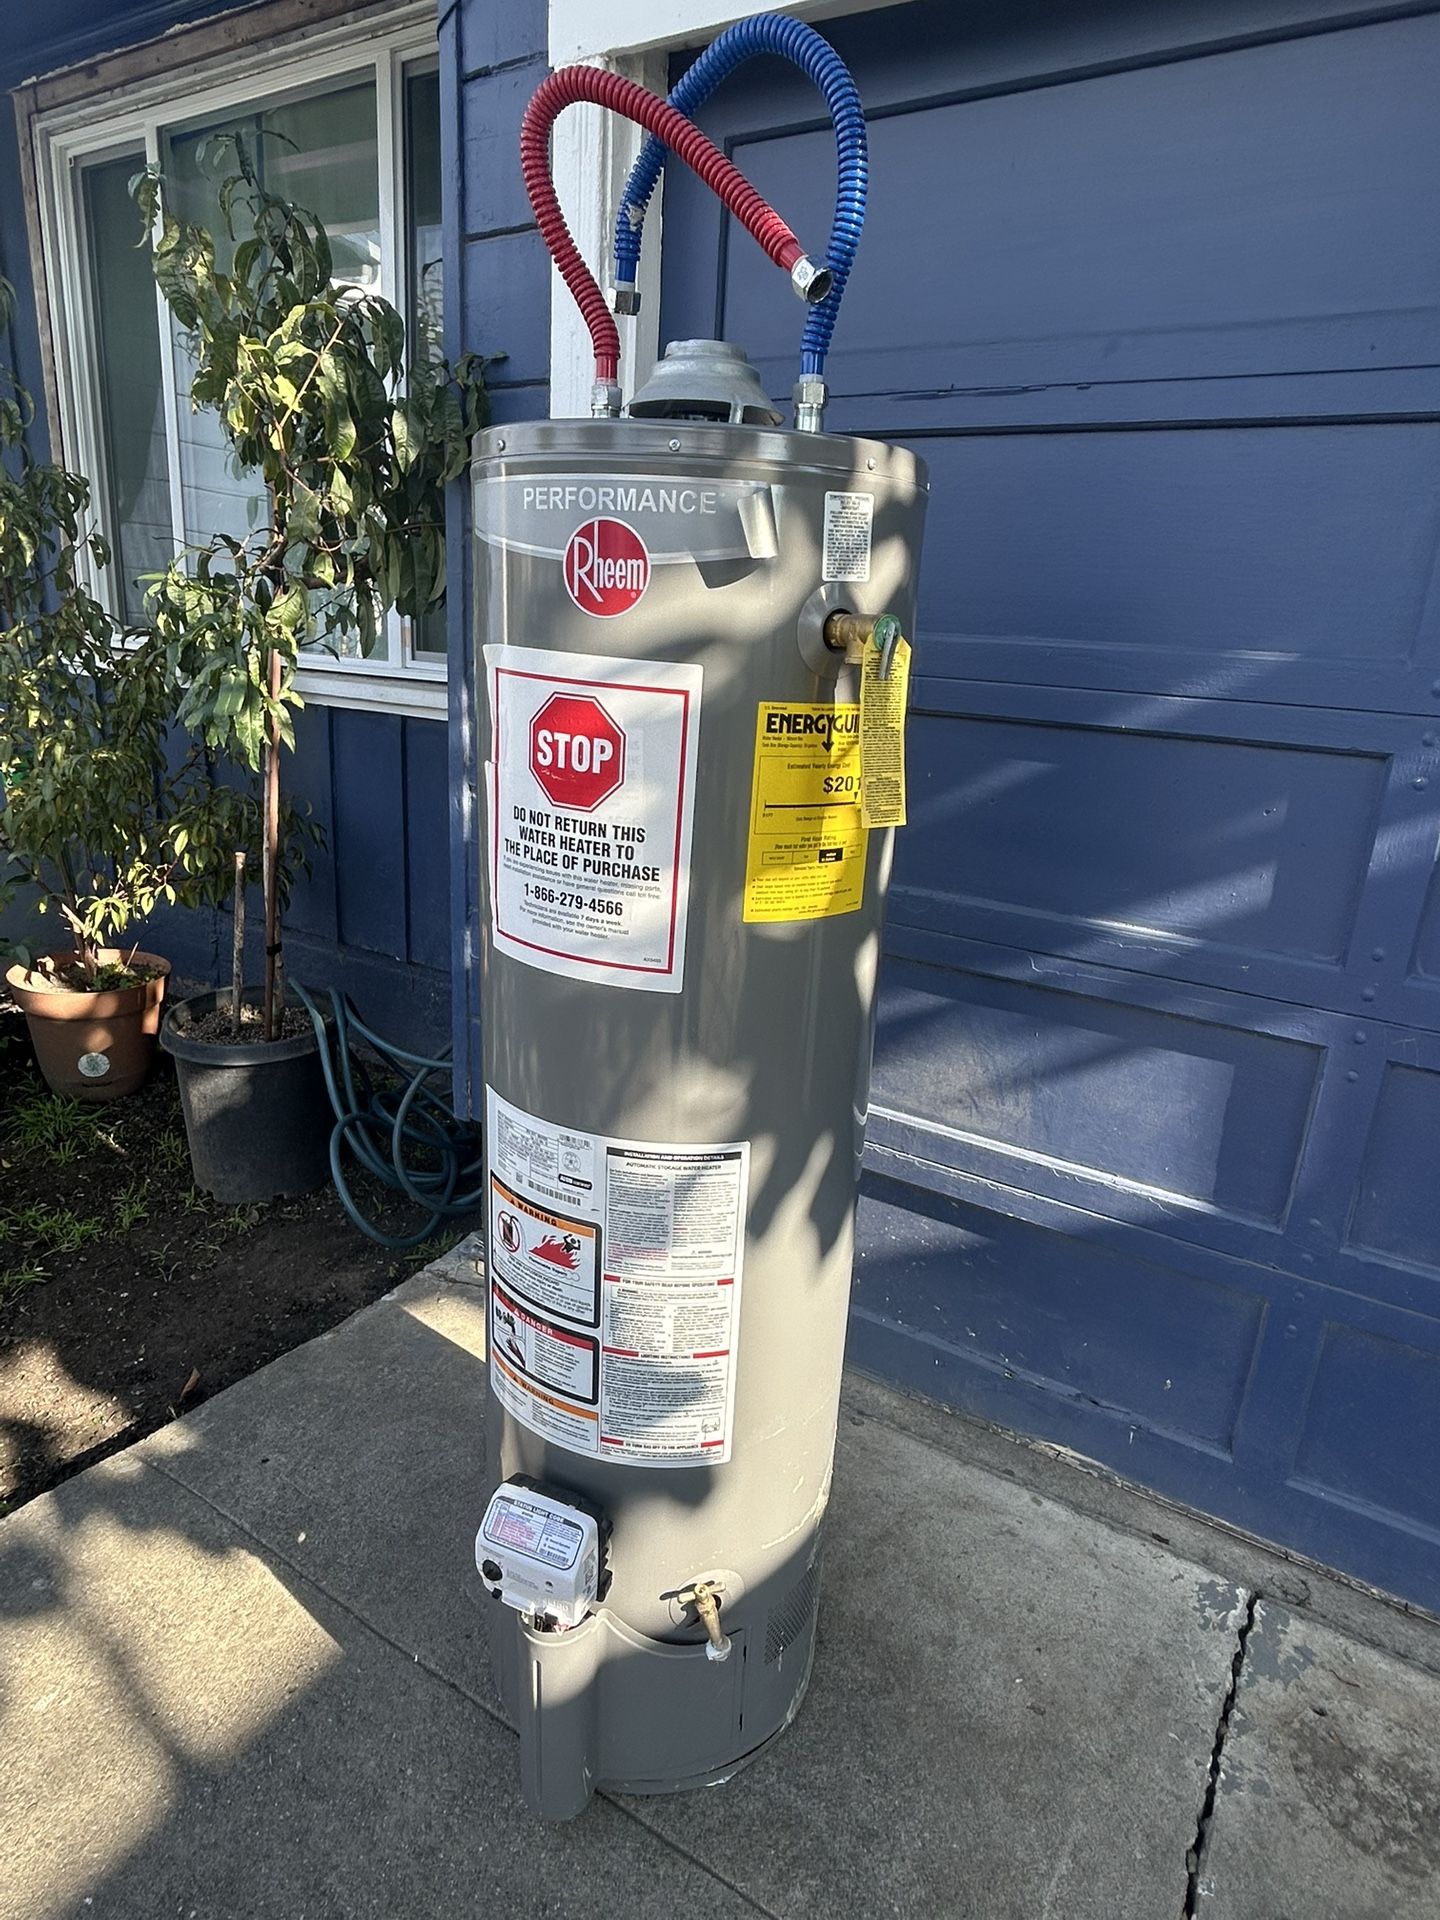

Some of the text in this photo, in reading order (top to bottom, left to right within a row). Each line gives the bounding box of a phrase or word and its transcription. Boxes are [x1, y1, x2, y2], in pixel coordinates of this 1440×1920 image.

[523, 487, 717, 514] PERFORMANCE
[573, 520, 644, 602] Rheem
[766, 713, 859, 734] ENERGYGUI
[537, 729, 613, 774] STOP
[513, 805, 646, 843] DO NOT RETURN THIS
[519, 825, 635, 861] WATER HEATER TO
[504, 838, 660, 882] THE PLACE OF PURCHASE
[532, 873, 556, 883] assistance
[524, 882, 623, 916] 1-866-279-4566
[558, 910, 580, 920] available
[586, 924, 606, 932] owner's
[624, 1151, 660, 1160] INSTALLATION
[518, 1201, 557, 1227] WARNING
[520, 1313, 553, 1335] DANGER
[521, 1380, 554, 1405] WARNING
[514, 1500, 533, 1511] STATUS
